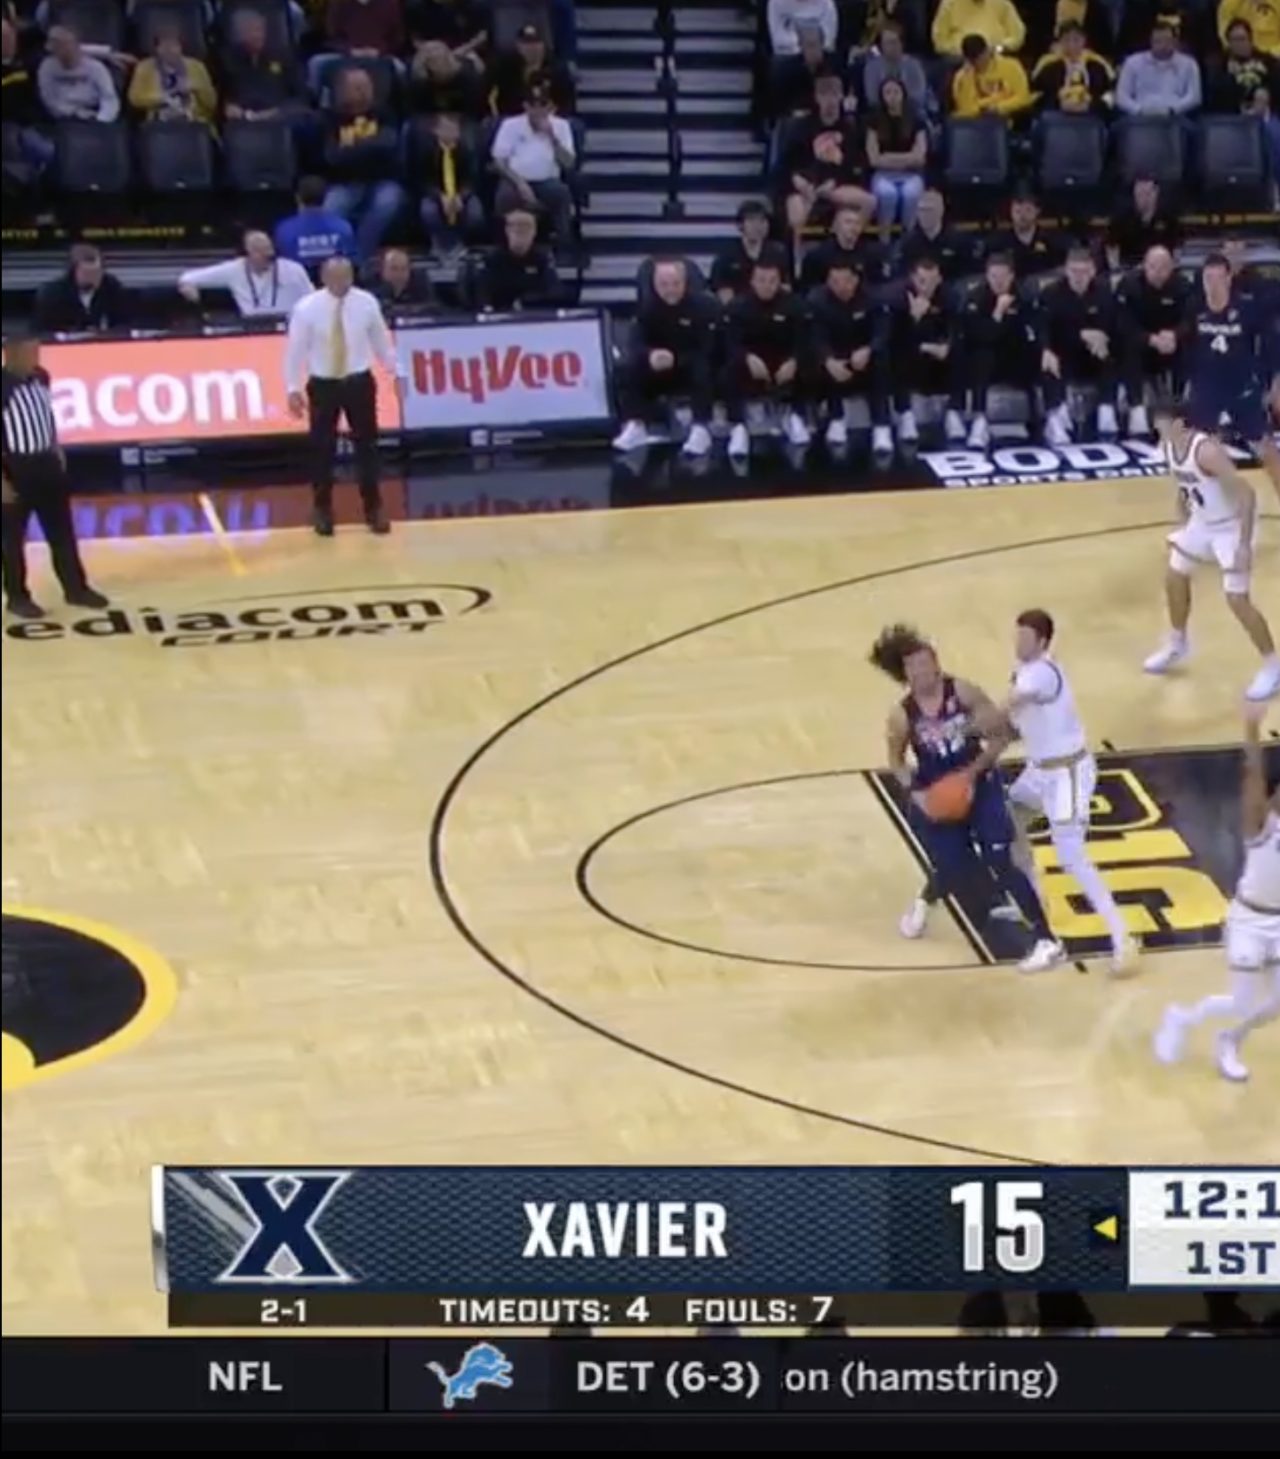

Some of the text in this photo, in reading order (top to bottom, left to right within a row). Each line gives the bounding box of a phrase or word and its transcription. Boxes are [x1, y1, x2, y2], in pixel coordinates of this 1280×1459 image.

[943, 471, 1086, 488] SPORTS
[4, 595, 444, 641] ediacom
[159, 621, 446, 648] COURT
